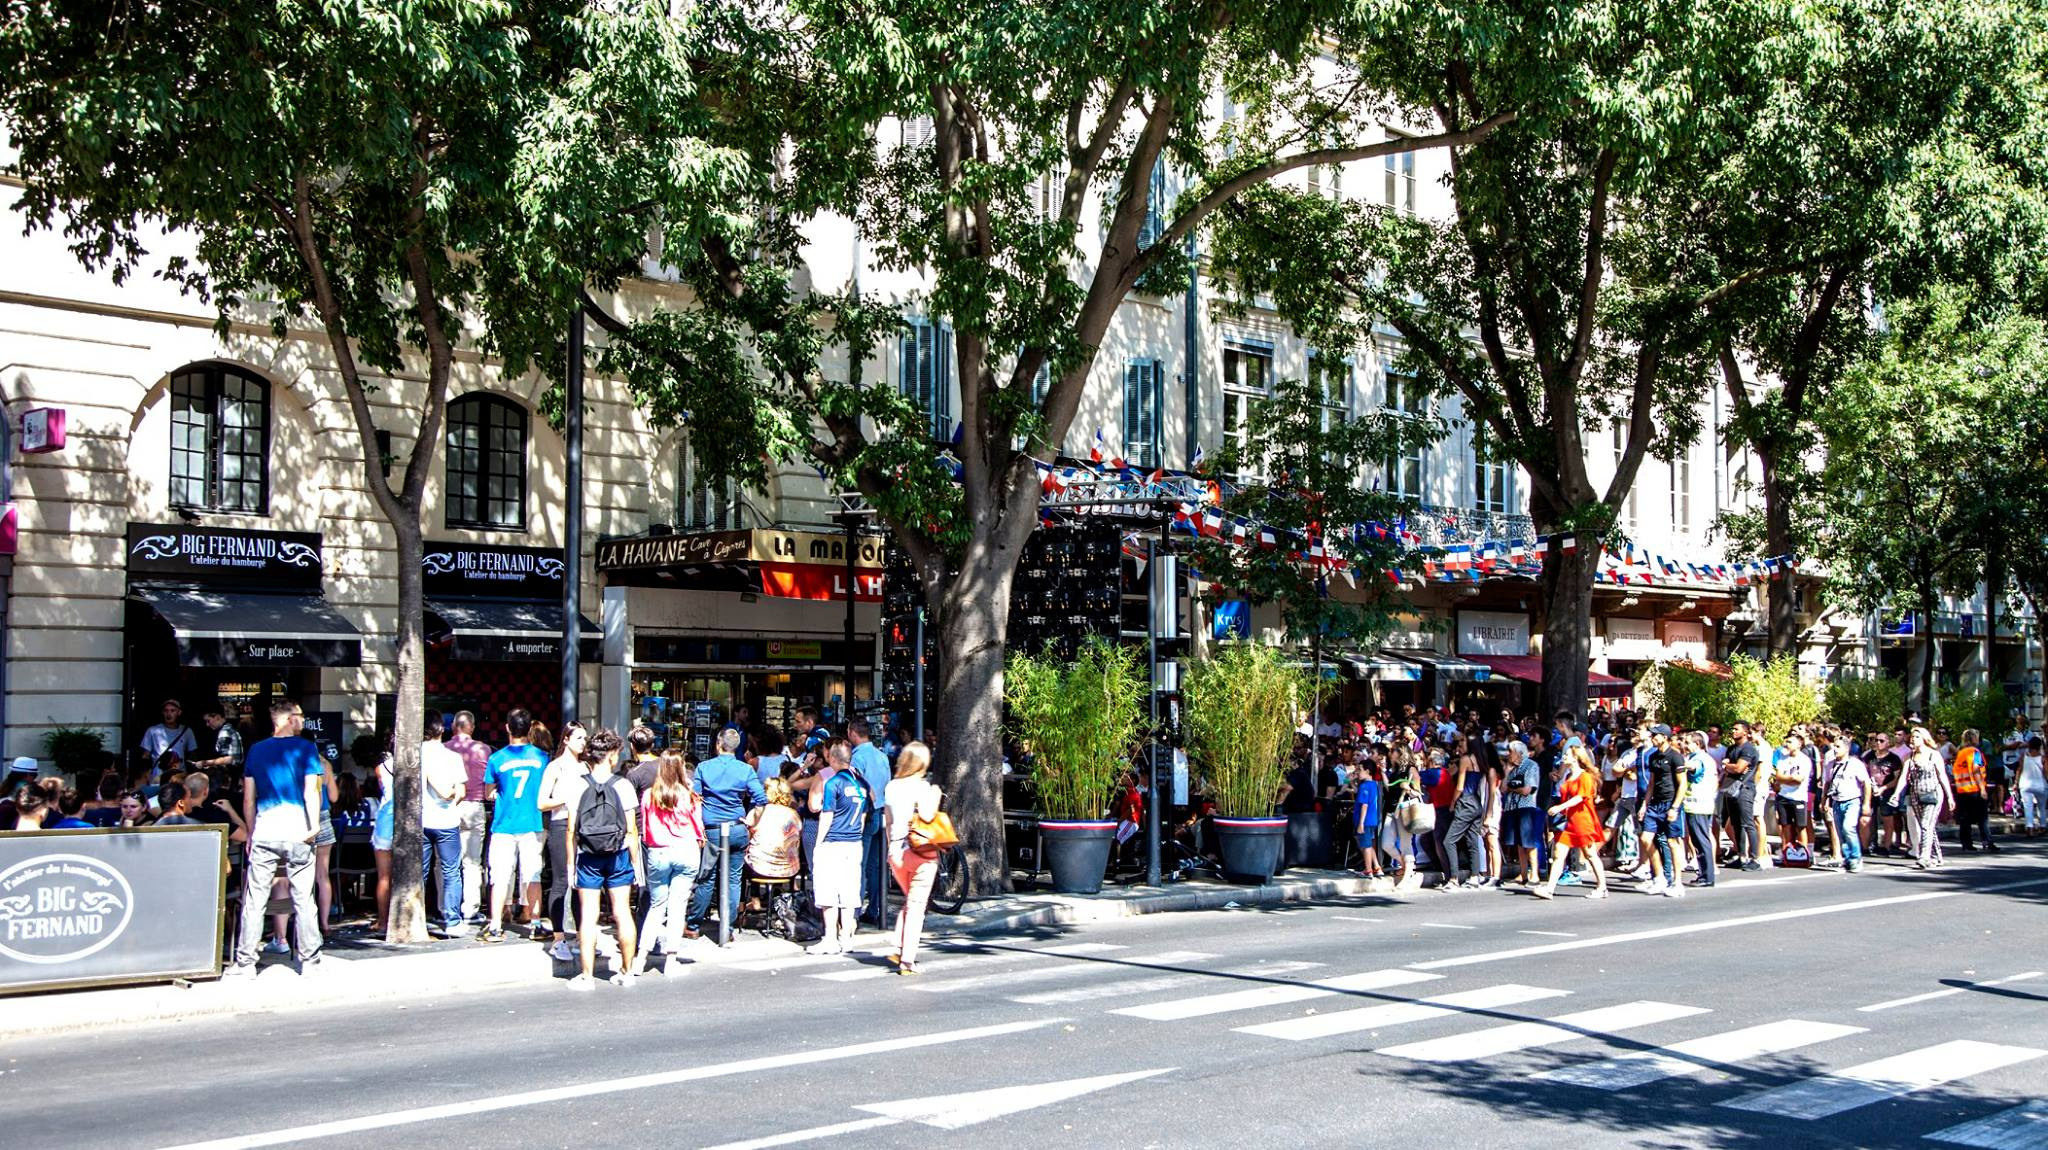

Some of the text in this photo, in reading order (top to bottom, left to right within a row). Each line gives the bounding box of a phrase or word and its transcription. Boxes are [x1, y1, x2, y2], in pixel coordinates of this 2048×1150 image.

[181, 534, 276, 558] BIG FERNAND
[599, 539, 688, 566] LA HAVANE
[690, 537, 711, 552] Cave
[774, 537, 795, 556] LA
[190, 555, 220, 566] L'atelier
[221, 557, 230, 566] du
[457, 552, 534, 572] BIG FERNAND
[464, 570, 488, 579] L'atelier
[489, 571, 497, 579] du
[1217, 614, 1242, 626] Krys
[1473, 626, 1516, 640] LIBRAIRIE
[249, 644, 294, 660] Sur place
[516, 642, 554, 655] emporter
[512, 769, 530, 799] 7
[850, 797, 865, 826] 7
[45, 863, 60, 874] du
[37, 886, 76, 912] BIG
[8, 914, 103, 941] FERNAND
